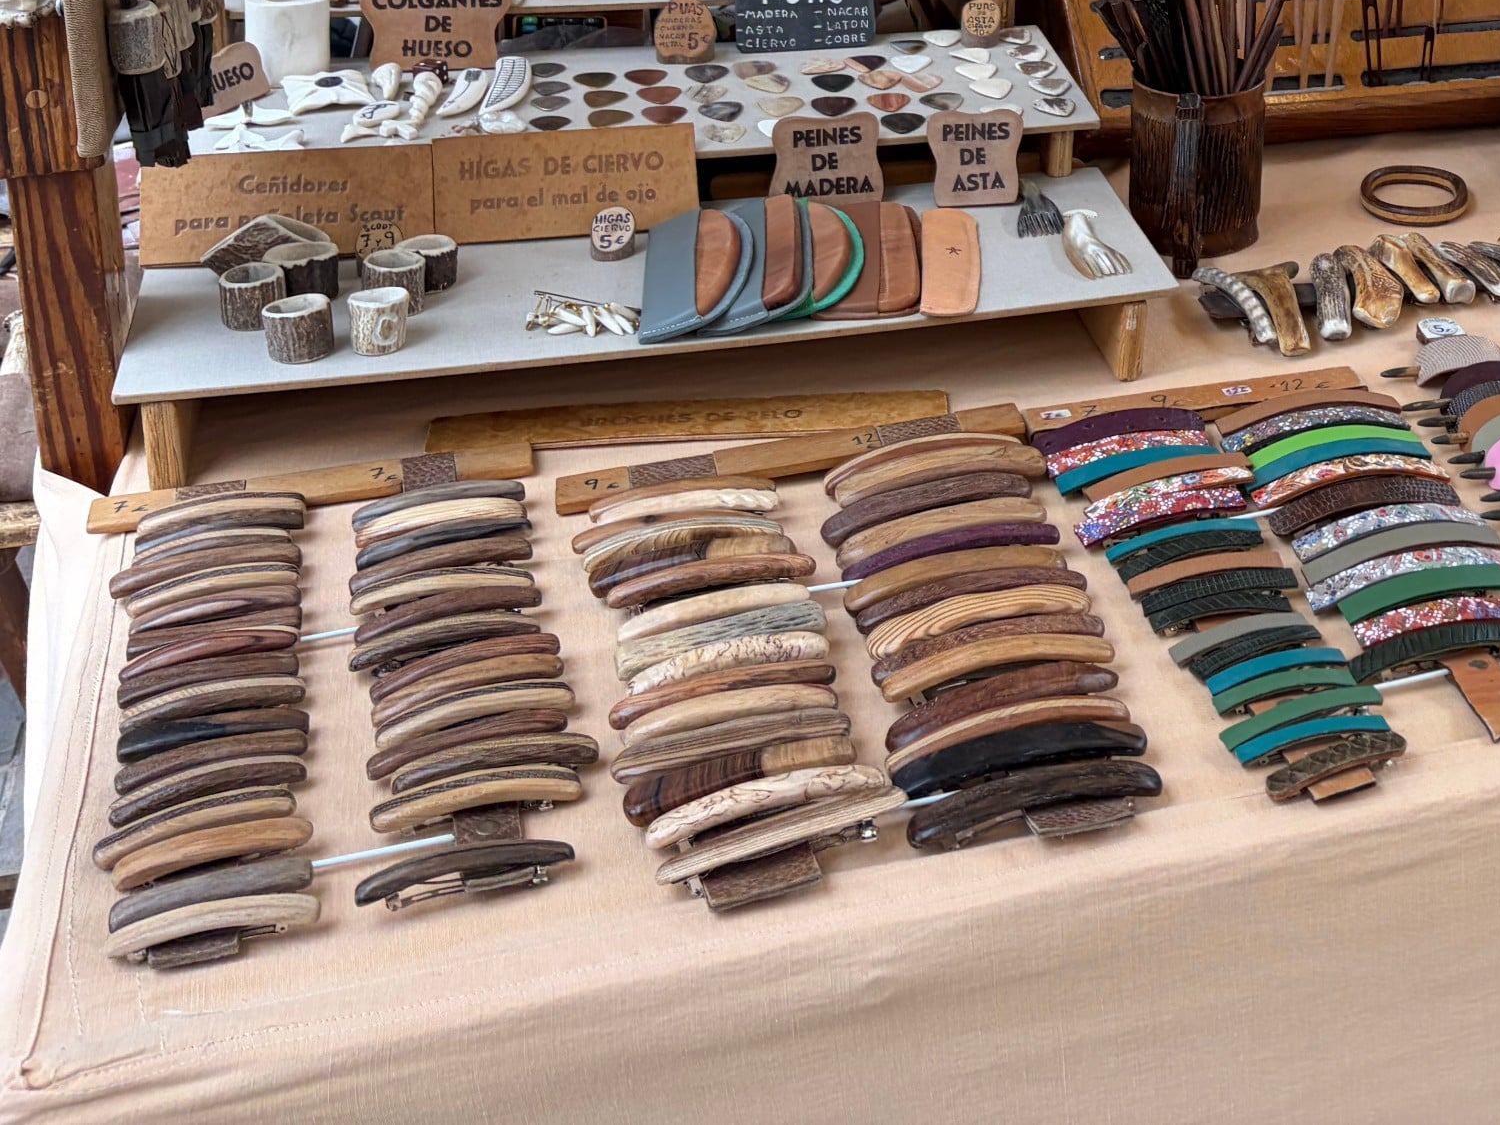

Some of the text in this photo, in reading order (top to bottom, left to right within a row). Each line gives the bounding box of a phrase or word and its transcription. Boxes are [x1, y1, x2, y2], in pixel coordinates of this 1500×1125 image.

[668, 2, 704, 15] PUAS
[425, 16, 452, 32] DE
[402, 40, 472, 58] HUESO
[793, 126, 862, 148] PEINES
[942, 122, 1011, 142] PEINES
[459, 151, 664, 180] HIGAS DE CIERVO
[812, 152, 838, 172] DE
[960, 148, 986, 166] DE
[239, 175, 348, 195] Ceñidores
[784, 176, 874, 197] MADERA
[952, 171, 1005, 192] ASTA
[470, 184, 656, 214] para el mal de ojo
[175, 216, 229, 236] para
[350, 203, 405, 222] Scout
[593, 224, 631, 232] CIERVO
[595, 213, 630, 224] HIGAS
[385, 231, 394, 245] 9
[706, 411, 735, 422] DE
[747, 409, 803, 421] PELO
